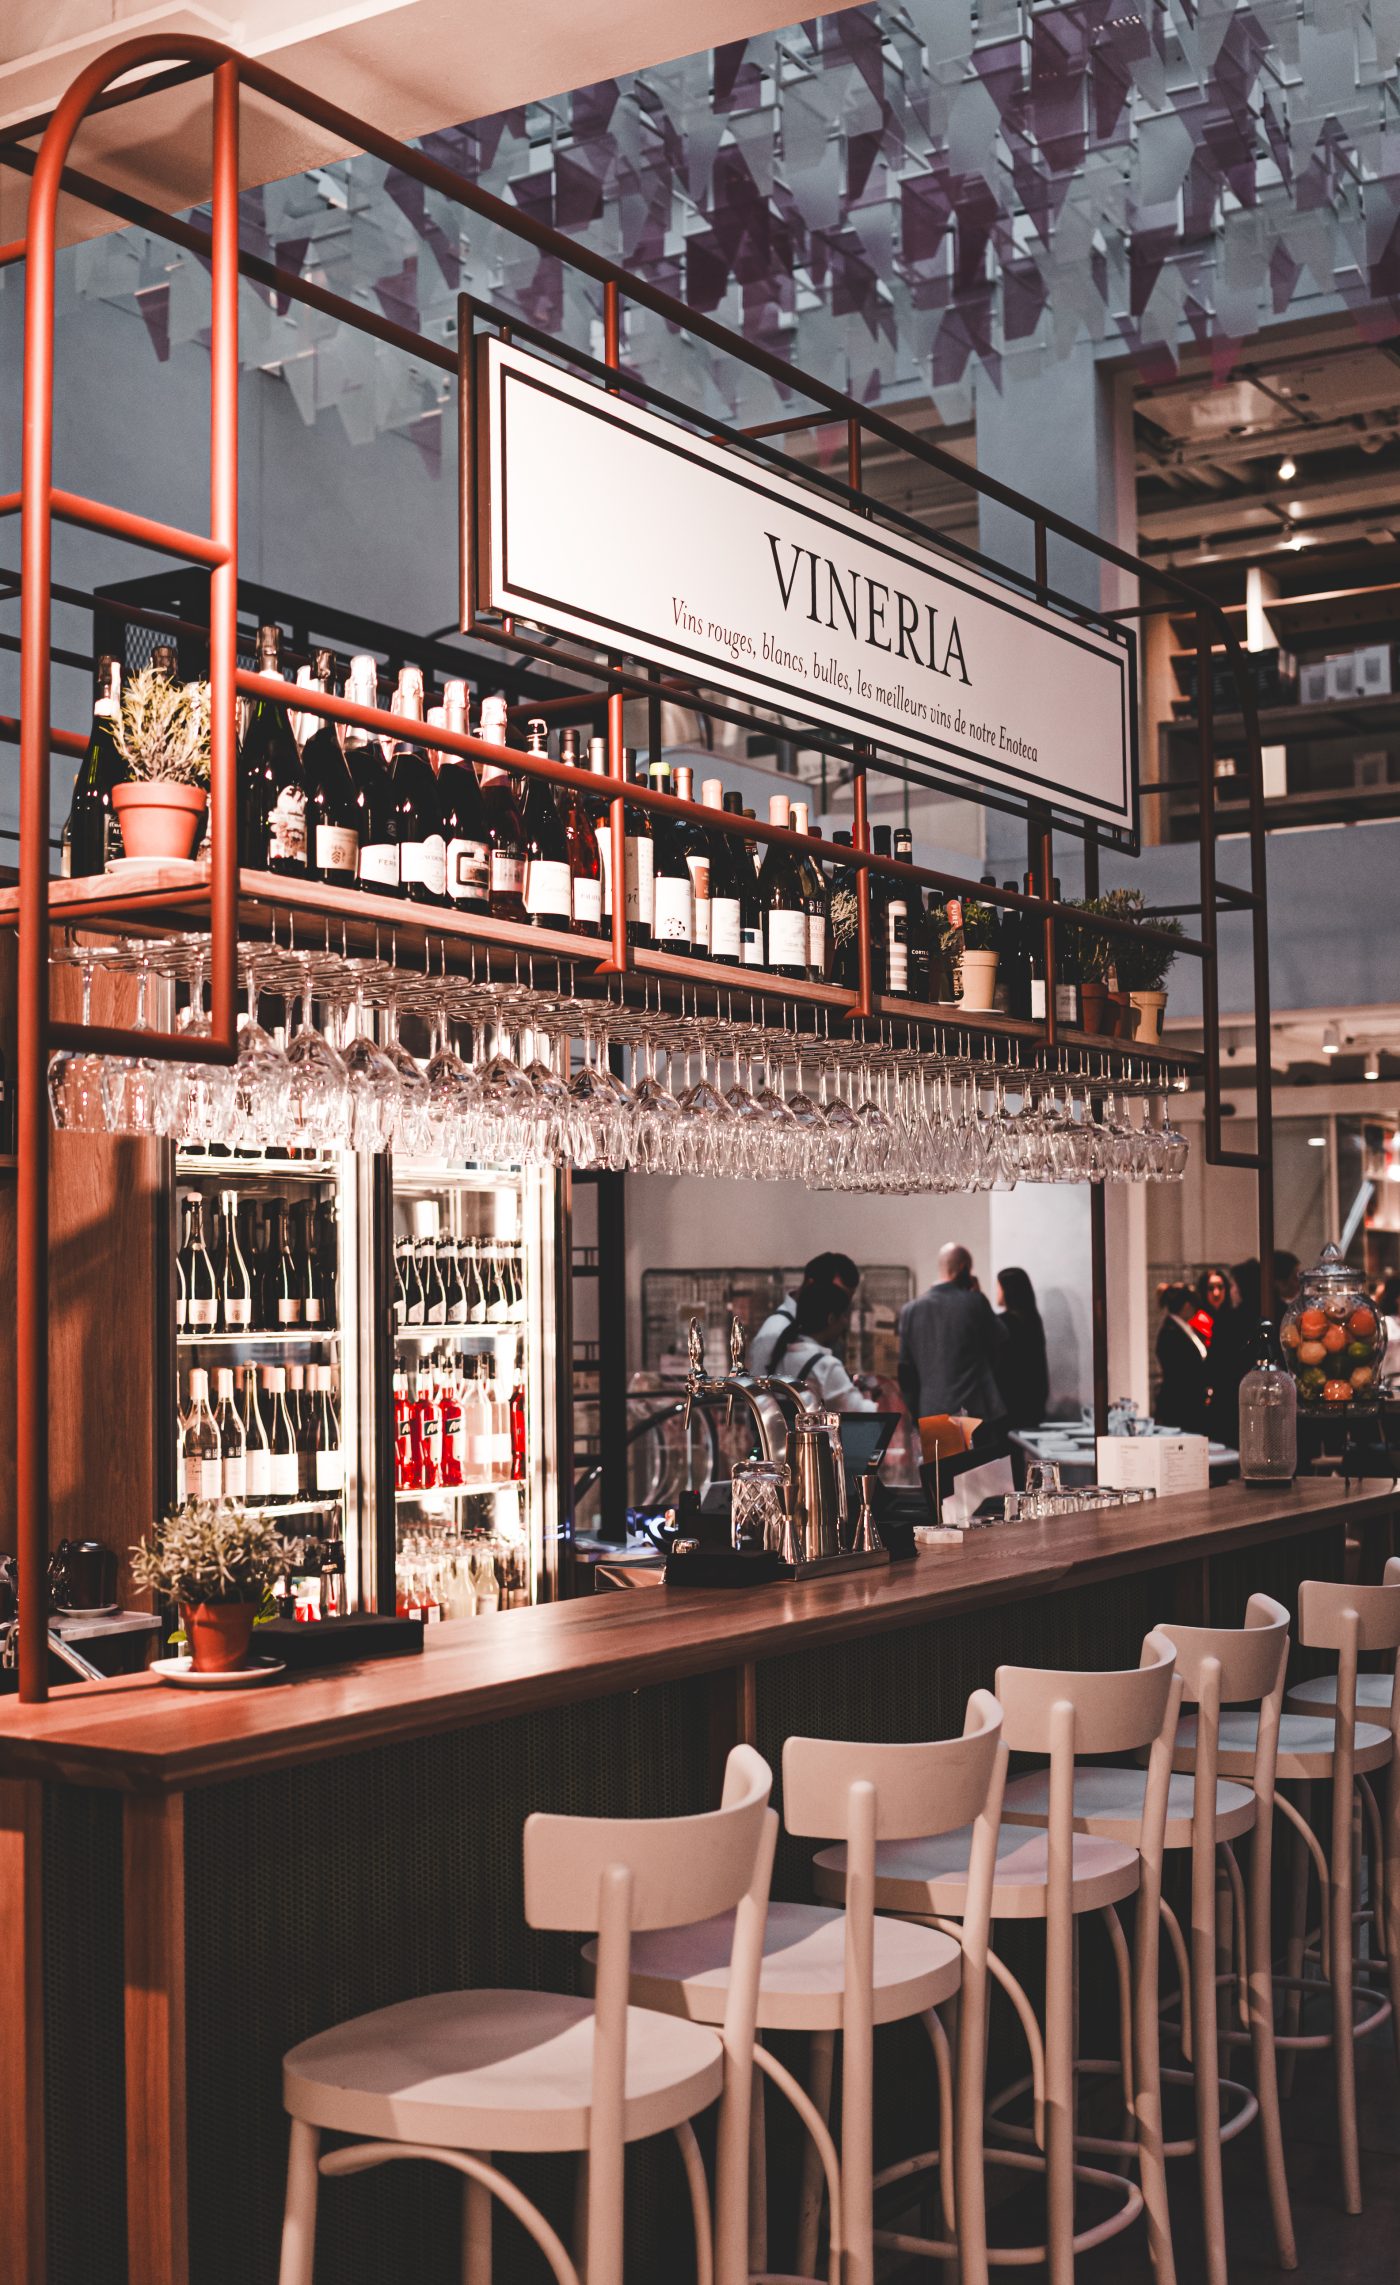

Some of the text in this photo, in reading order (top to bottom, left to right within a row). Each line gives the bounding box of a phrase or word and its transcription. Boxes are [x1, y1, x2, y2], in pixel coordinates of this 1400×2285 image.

[672, 596, 1039, 763] Vins rouges, blancs, bulles, les meilleurs vins de notre Enoteca
[764, 532, 973, 686] VINERIA
[950, 903, 960, 925] PURE
